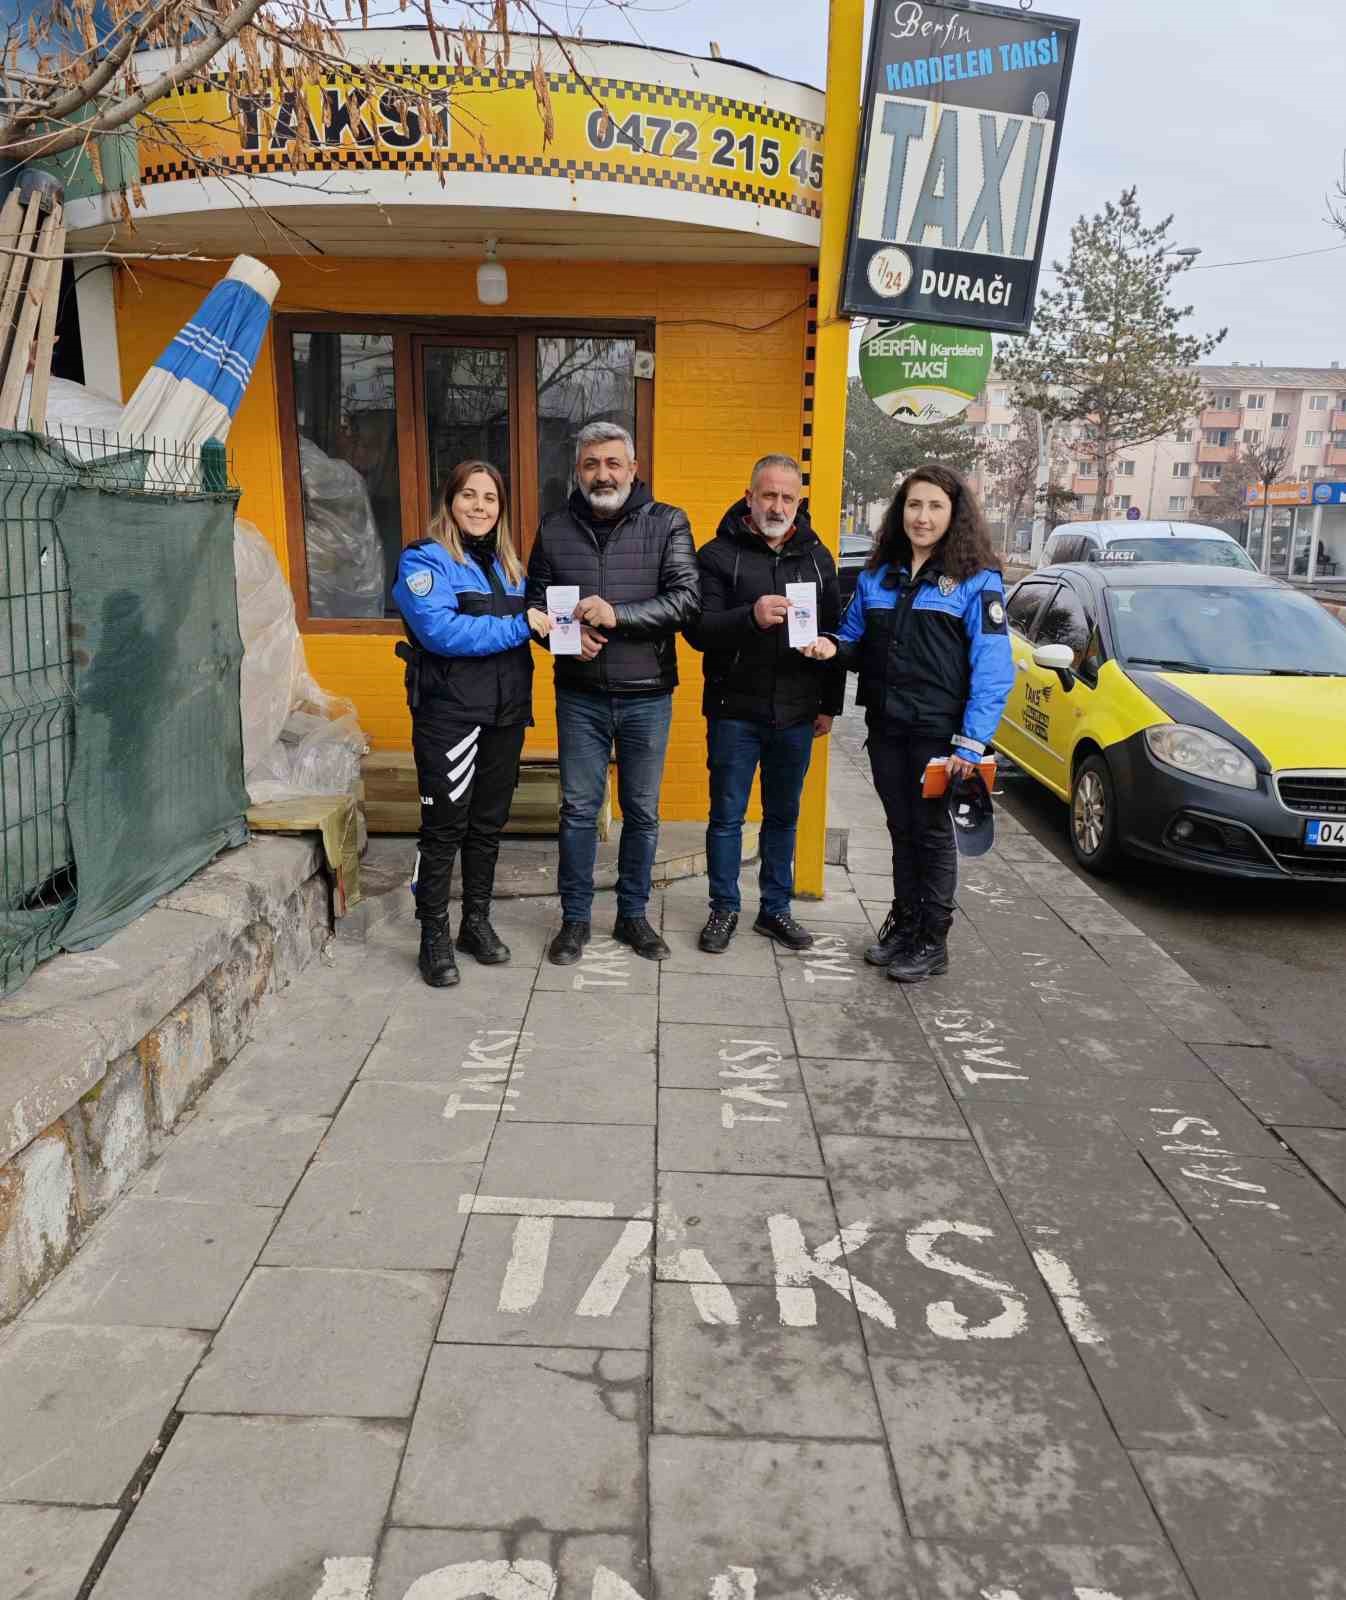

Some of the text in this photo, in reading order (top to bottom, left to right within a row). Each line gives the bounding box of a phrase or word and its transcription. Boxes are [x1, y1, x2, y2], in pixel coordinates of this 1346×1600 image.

[889, 1, 972, 48] Berfin
[886, 31, 1059, 91] KARDELEN TAKSİ
[587, 109, 823, 190] 0472 215 45
[877, 255, 903, 290] 7/24
[919, 269, 1012, 306] DURAĞI
[901, 357, 948, 379] TAKSİ
[1320, 823, 1345, 843] 04
